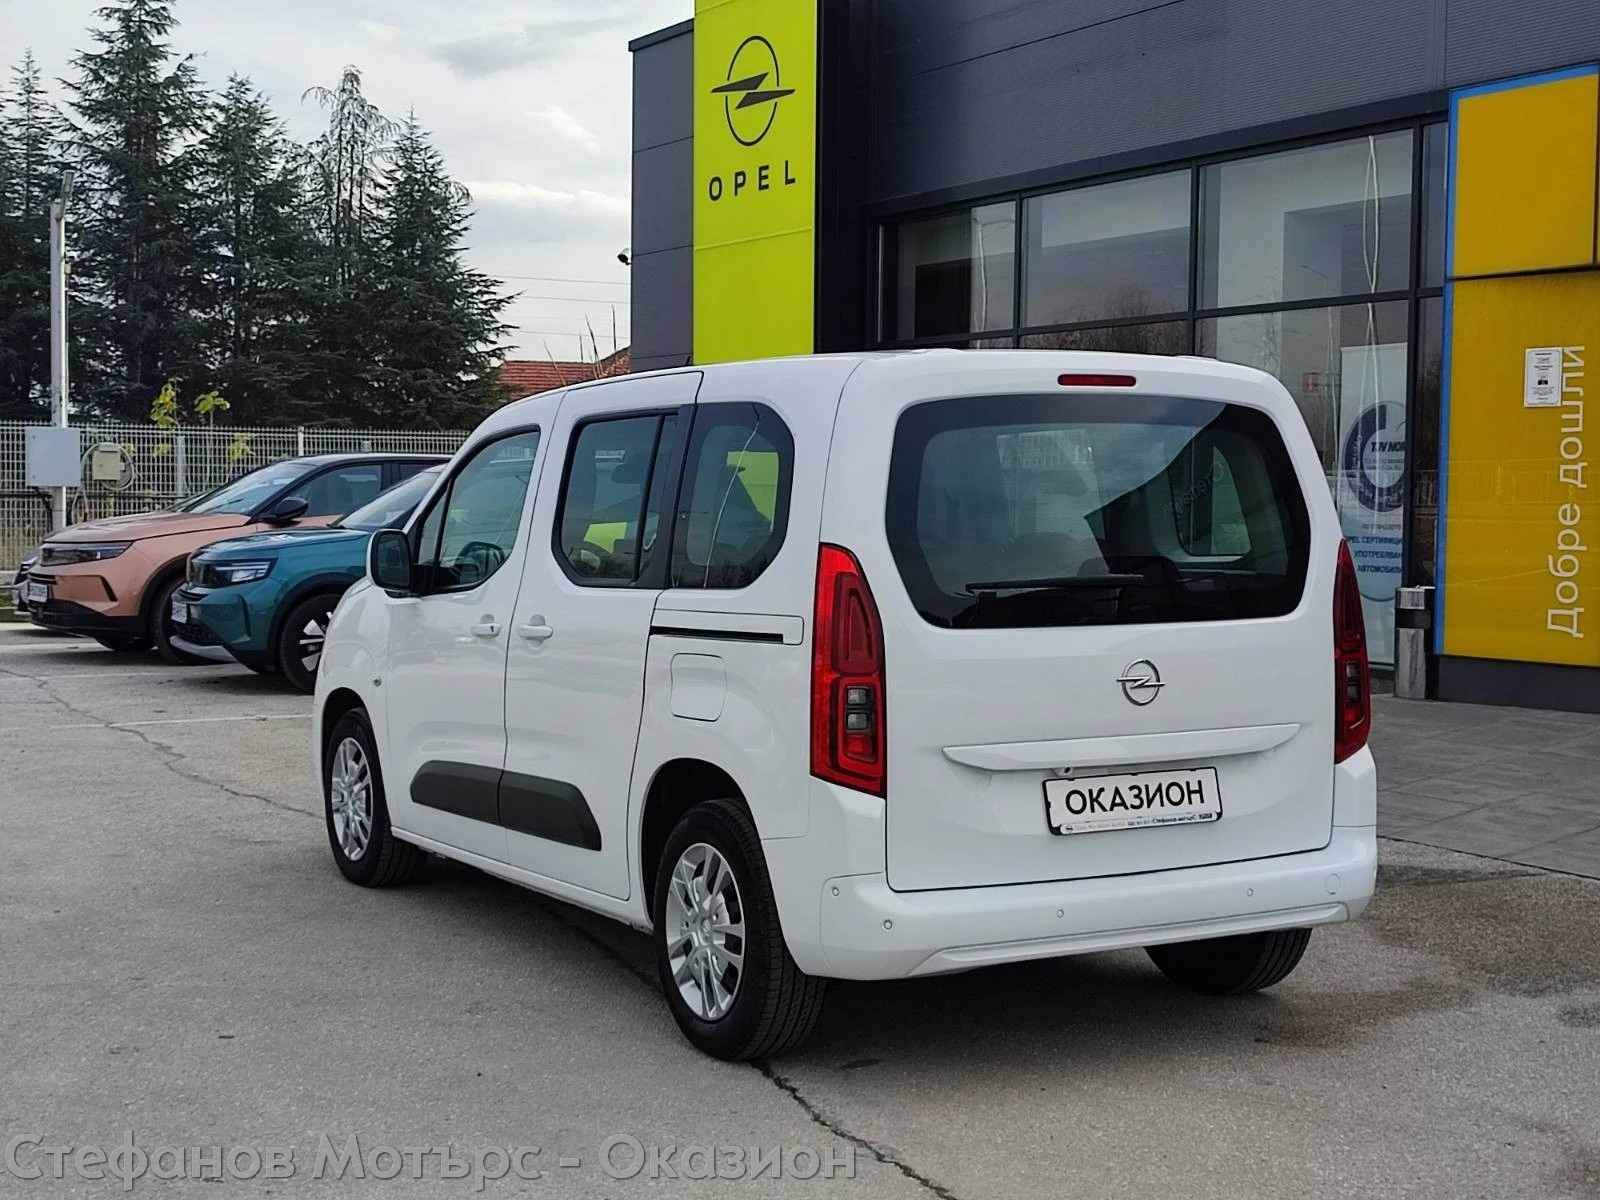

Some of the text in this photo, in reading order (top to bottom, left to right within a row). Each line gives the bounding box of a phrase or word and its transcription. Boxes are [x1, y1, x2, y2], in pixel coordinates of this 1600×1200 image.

[708, 160, 797, 202] OPEL
[1547, 346, 1588, 638] Добре дошли
[1065, 780, 1205, 815] ОКАЗИОН
